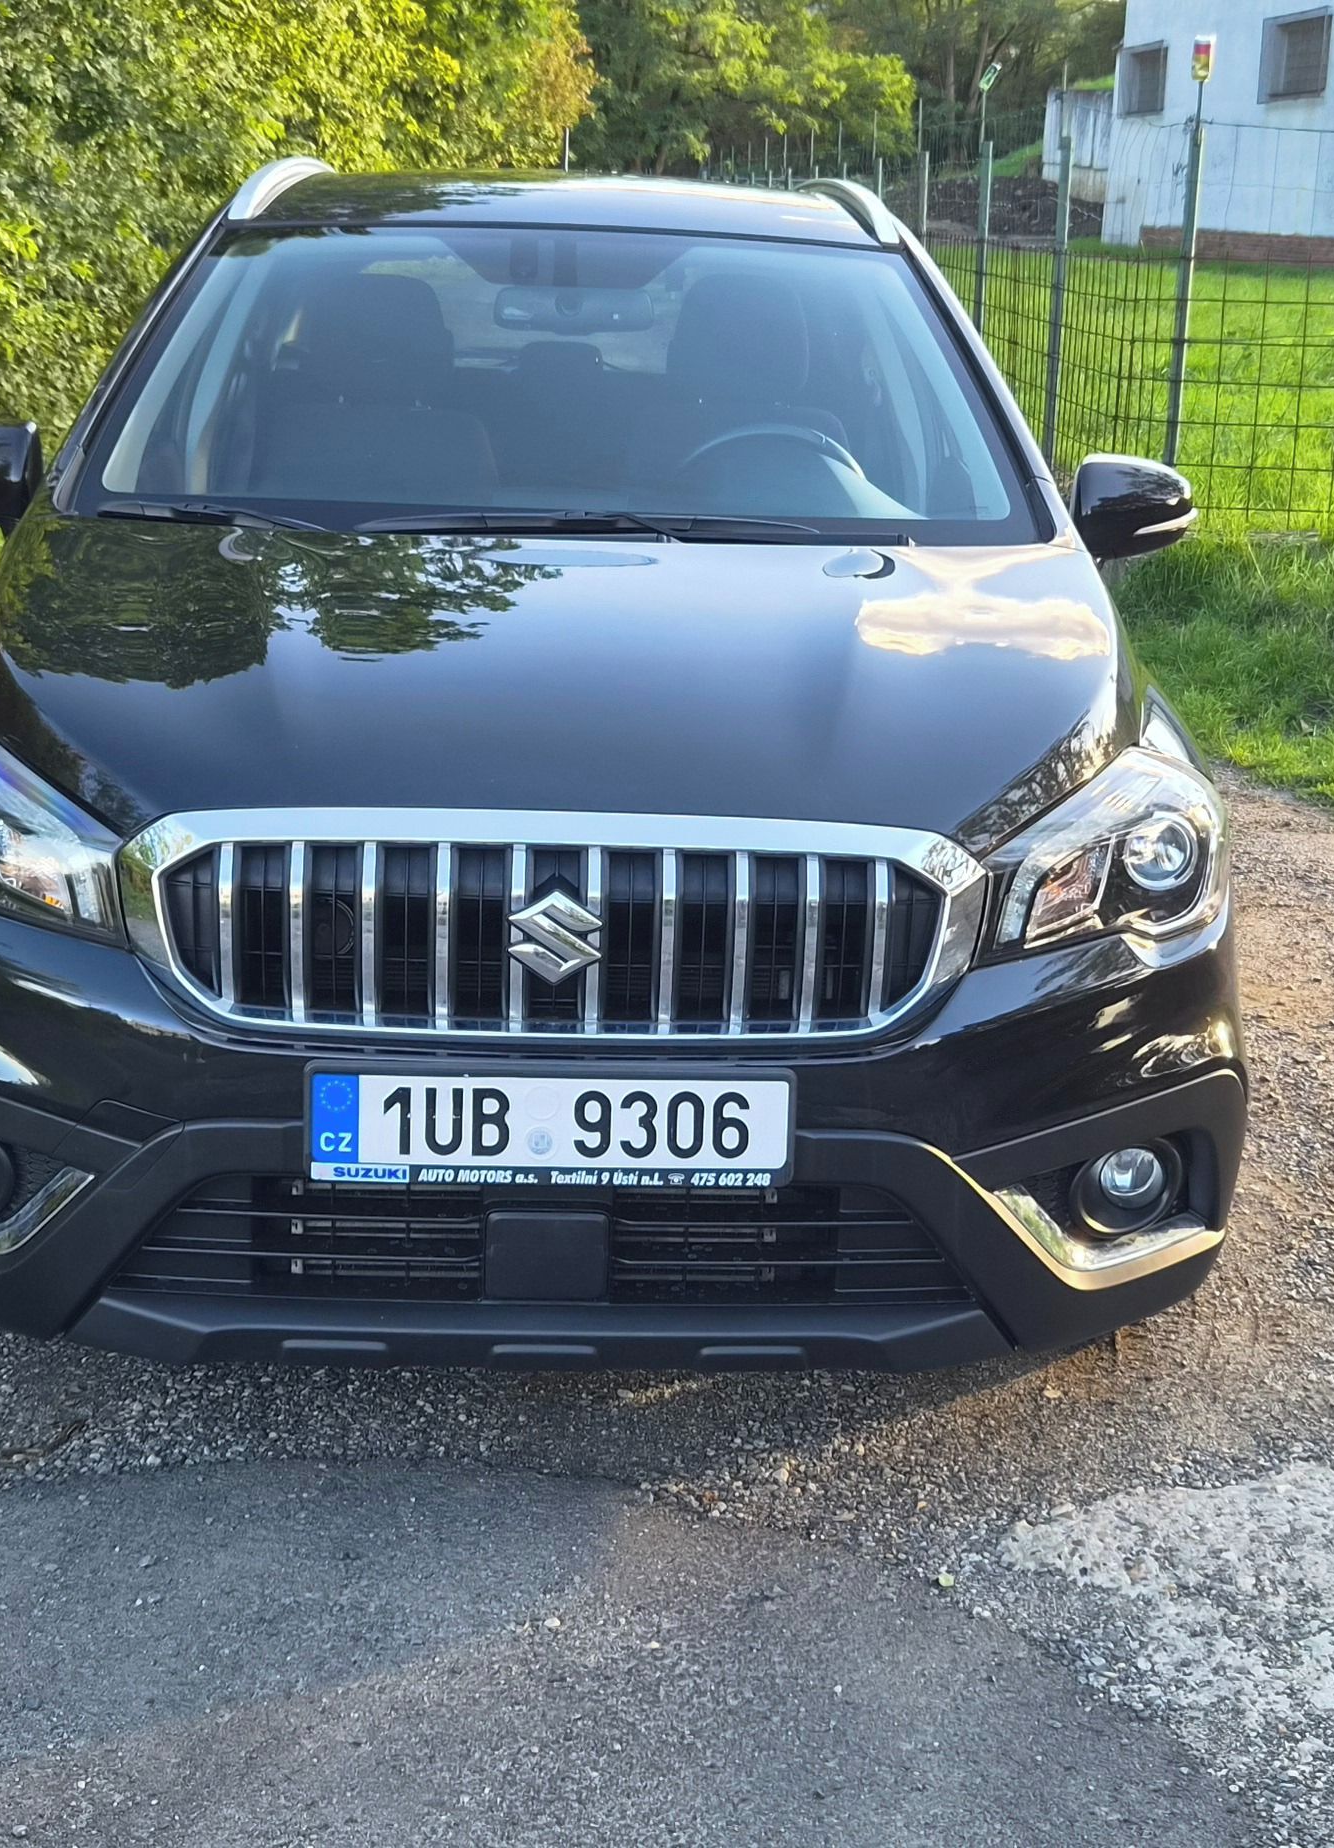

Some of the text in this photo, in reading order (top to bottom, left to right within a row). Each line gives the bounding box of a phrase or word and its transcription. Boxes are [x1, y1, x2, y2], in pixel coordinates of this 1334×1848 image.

[383, 1086, 750, 1159] 1UB 9306
[319, 1131, 353, 1154] CZ
[333, 1166, 408, 1180] SUZUKI
[418, 1168, 453, 1183] AUTO
[456, 1169, 513, 1184] MOTORS
[515, 1171, 539, 1184] a.s.
[550, 1170, 598, 1185] Textilní
[601, 1171, 610, 1185] 9
[613, 1169, 639, 1186] Ústí
[690, 1172, 716, 1186] 475
[718, 1173, 742, 1187] 602
[746, 1173, 771, 1187] 248
